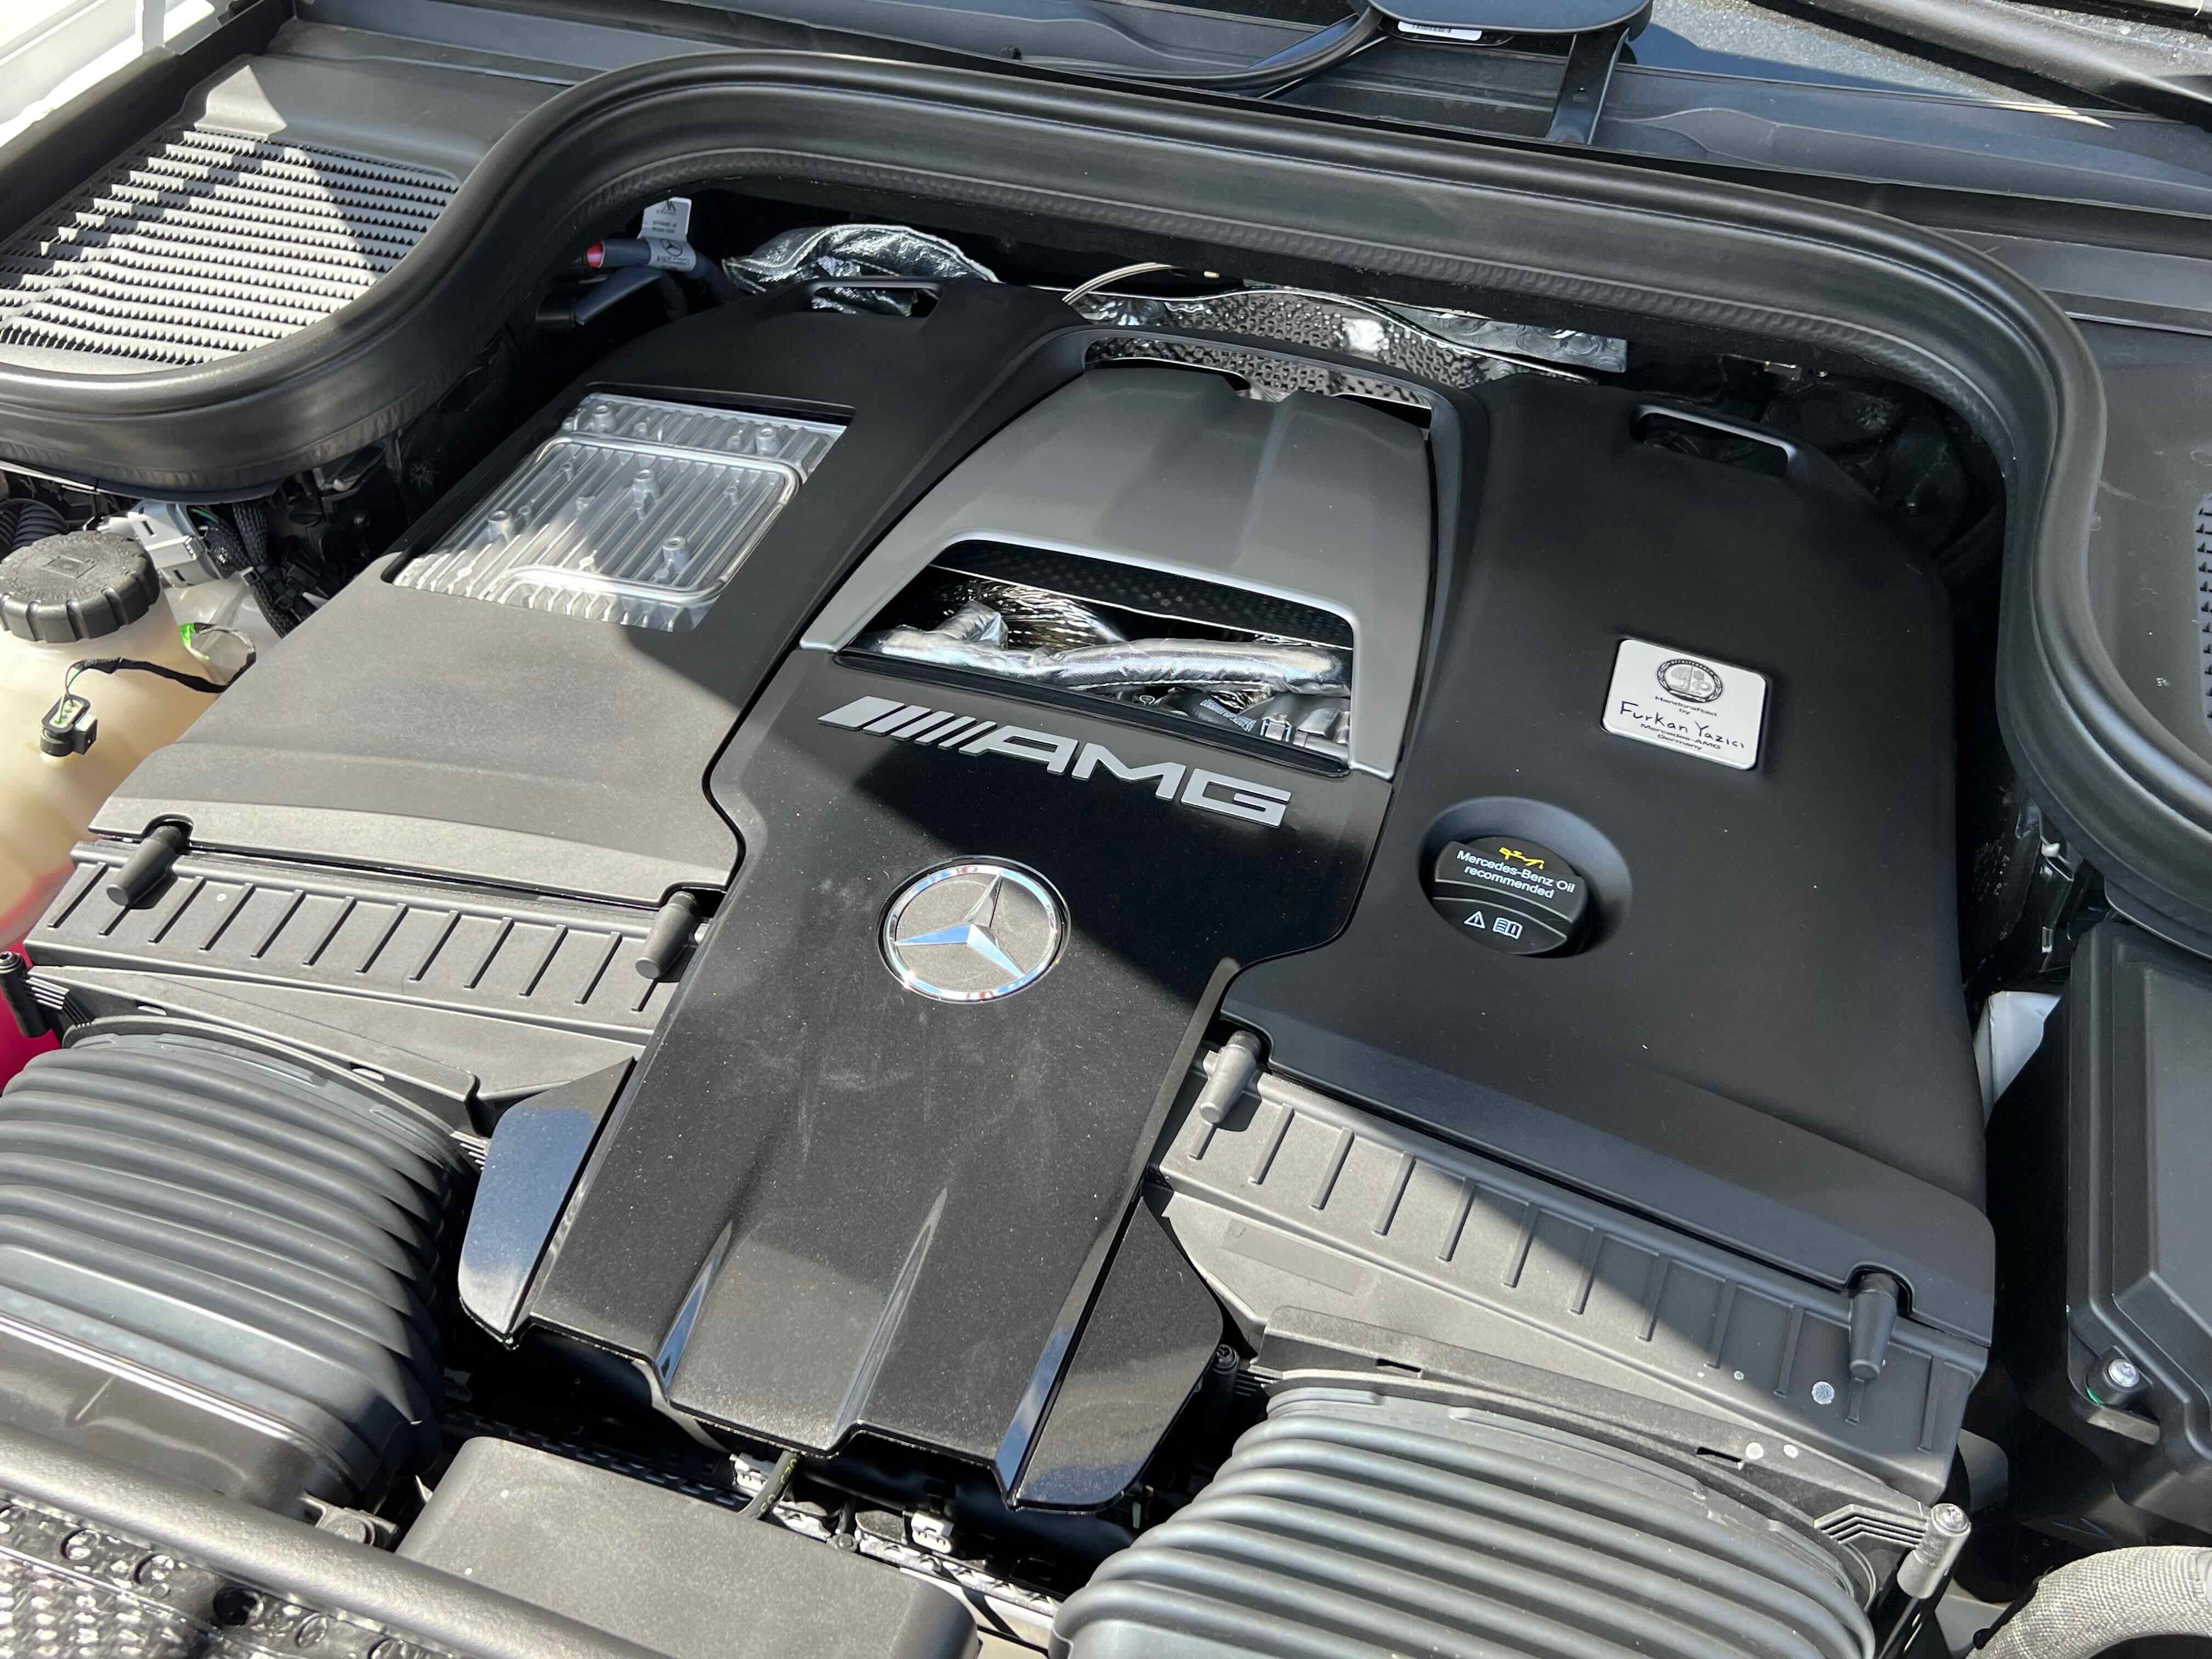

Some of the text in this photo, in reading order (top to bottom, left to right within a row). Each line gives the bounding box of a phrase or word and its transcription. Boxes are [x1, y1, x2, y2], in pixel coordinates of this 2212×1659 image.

[1620, 701, 1688, 733] Furkan
[1655, 696, 1717, 716] Handcrafted
[1640, 723, 1721, 749] Mercedes-AMG
[1657, 733, 1702, 751] Germany
[959, 724, 1291, 828] AMG
[1457, 850, 1576, 894] Mercedes-Benz Oil
[1464, 865, 1555, 899] recommended
